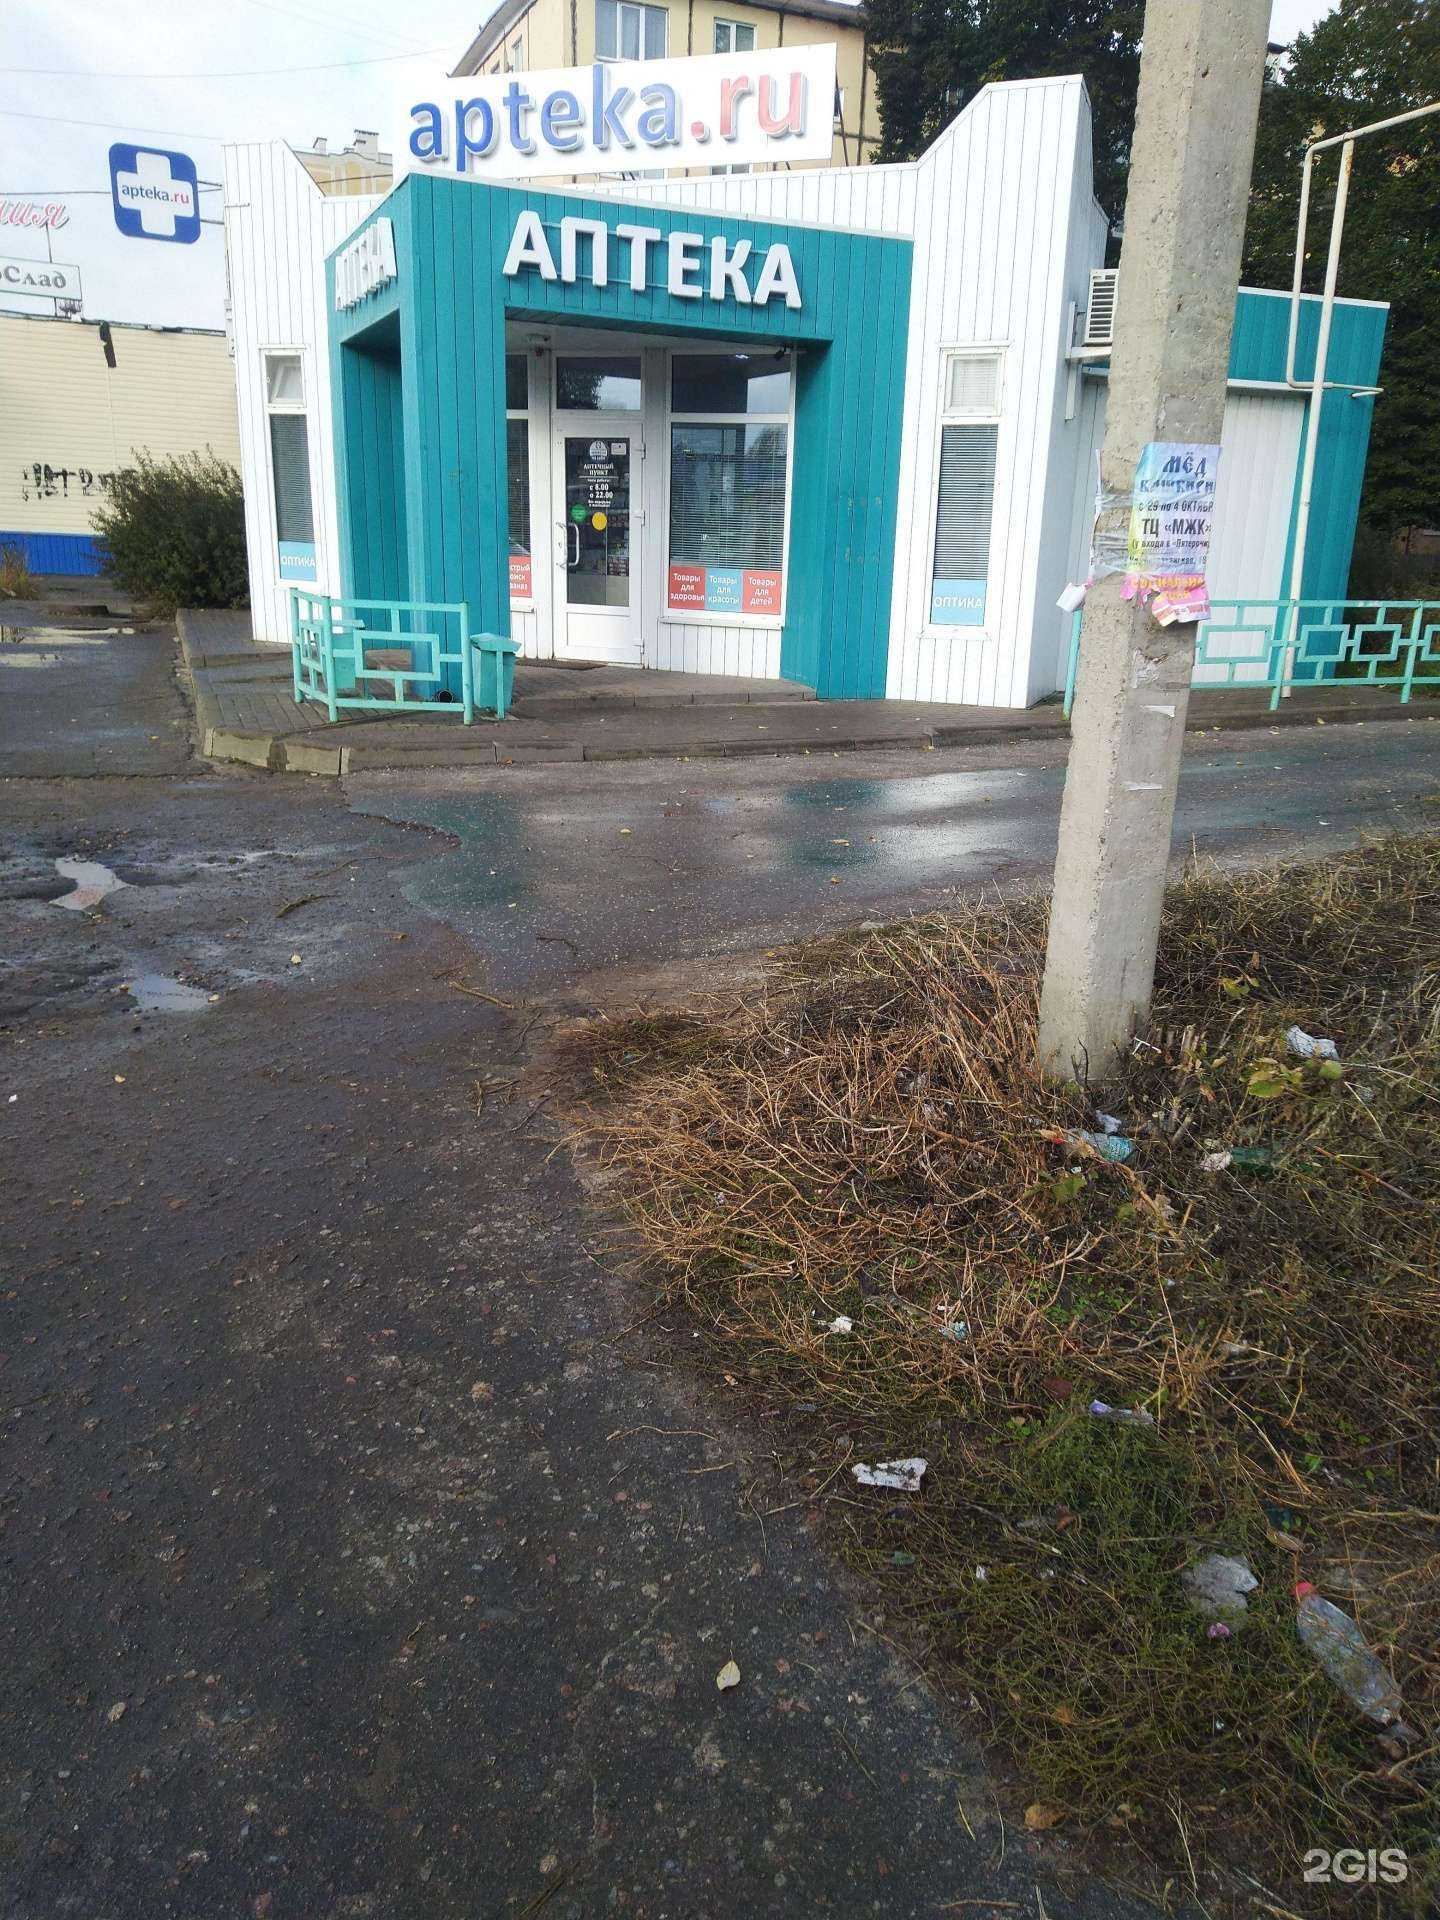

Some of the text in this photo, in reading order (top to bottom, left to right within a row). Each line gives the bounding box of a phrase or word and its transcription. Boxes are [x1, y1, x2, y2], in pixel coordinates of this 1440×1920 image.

[409, 63, 806, 172] apteka.ru
[121, 184, 189, 204] apteka.ru
[503, 210, 802, 309] АПТЕКА
[0, 265, 67, 289] Слад
[1162, 452, 1207, 478] МЁД
[1141, 518, 1160, 538] ТЦ
[674, 573, 701, 583] Товары
[710, 576, 737, 585] Товары
[748, 577, 777, 587] Товары
[716, 587, 731, 595] для
[754, 589, 769, 597] для
[670, 593, 705, 602] здоровья
[708, 597, 740, 606] красоты
[750, 597, 773, 606] детей
[934, 596, 984, 609] ОПТИКА
